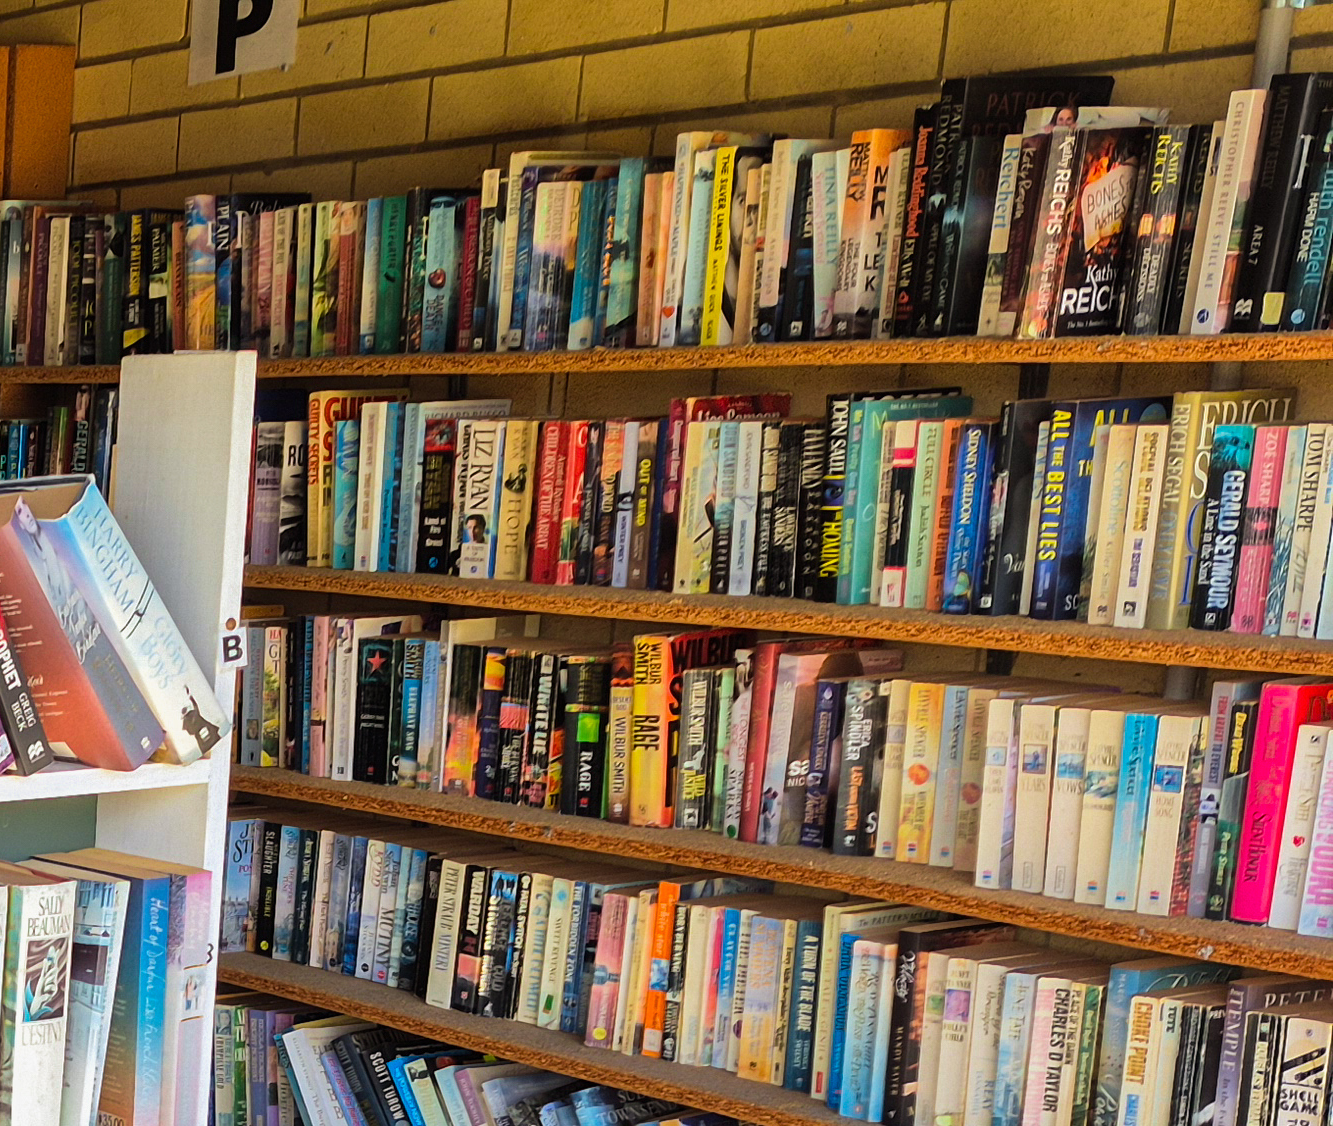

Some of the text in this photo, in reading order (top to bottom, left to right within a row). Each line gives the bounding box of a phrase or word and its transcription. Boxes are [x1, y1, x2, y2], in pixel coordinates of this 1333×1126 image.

[993, 147, 1019, 230] Reichert
[1086, 175, 1125, 214] BONES
[1085, 265, 1117, 285] Kathy
[959, 429, 981, 524] SIDNEY SHELDON
[1163, 403, 1191, 509] ERICH SEGAL
[469, 463, 493, 511] RYAN
[1038, 410, 1072, 560] ALL THE BEST LIES
[93, 506, 138, 578] HARRY
[506, 499, 521, 555] HOPE
[1207, 470, 1245, 610] GERALD SEYMOUR
[75, 506, 136, 613] BINGHAM
[222, 635, 243, 662] B
[634, 642, 662, 685] WILBUR SMITH
[11, 692, 37, 733] GREIG BECK
[634, 715, 660, 752] RAGE
[579, 751, 594, 792] RAGE
[612, 716, 627, 793] WILBUR SMITH
[27, 914, 71, 936] BEAUMAN
[37, 894, 64, 916] SALLY
[1048, 988, 1070, 1049] CHARLES
[370, 1052, 405, 1121] SCOTT TUROW
[1041, 1063, 1062, 1113] TAYLOR
